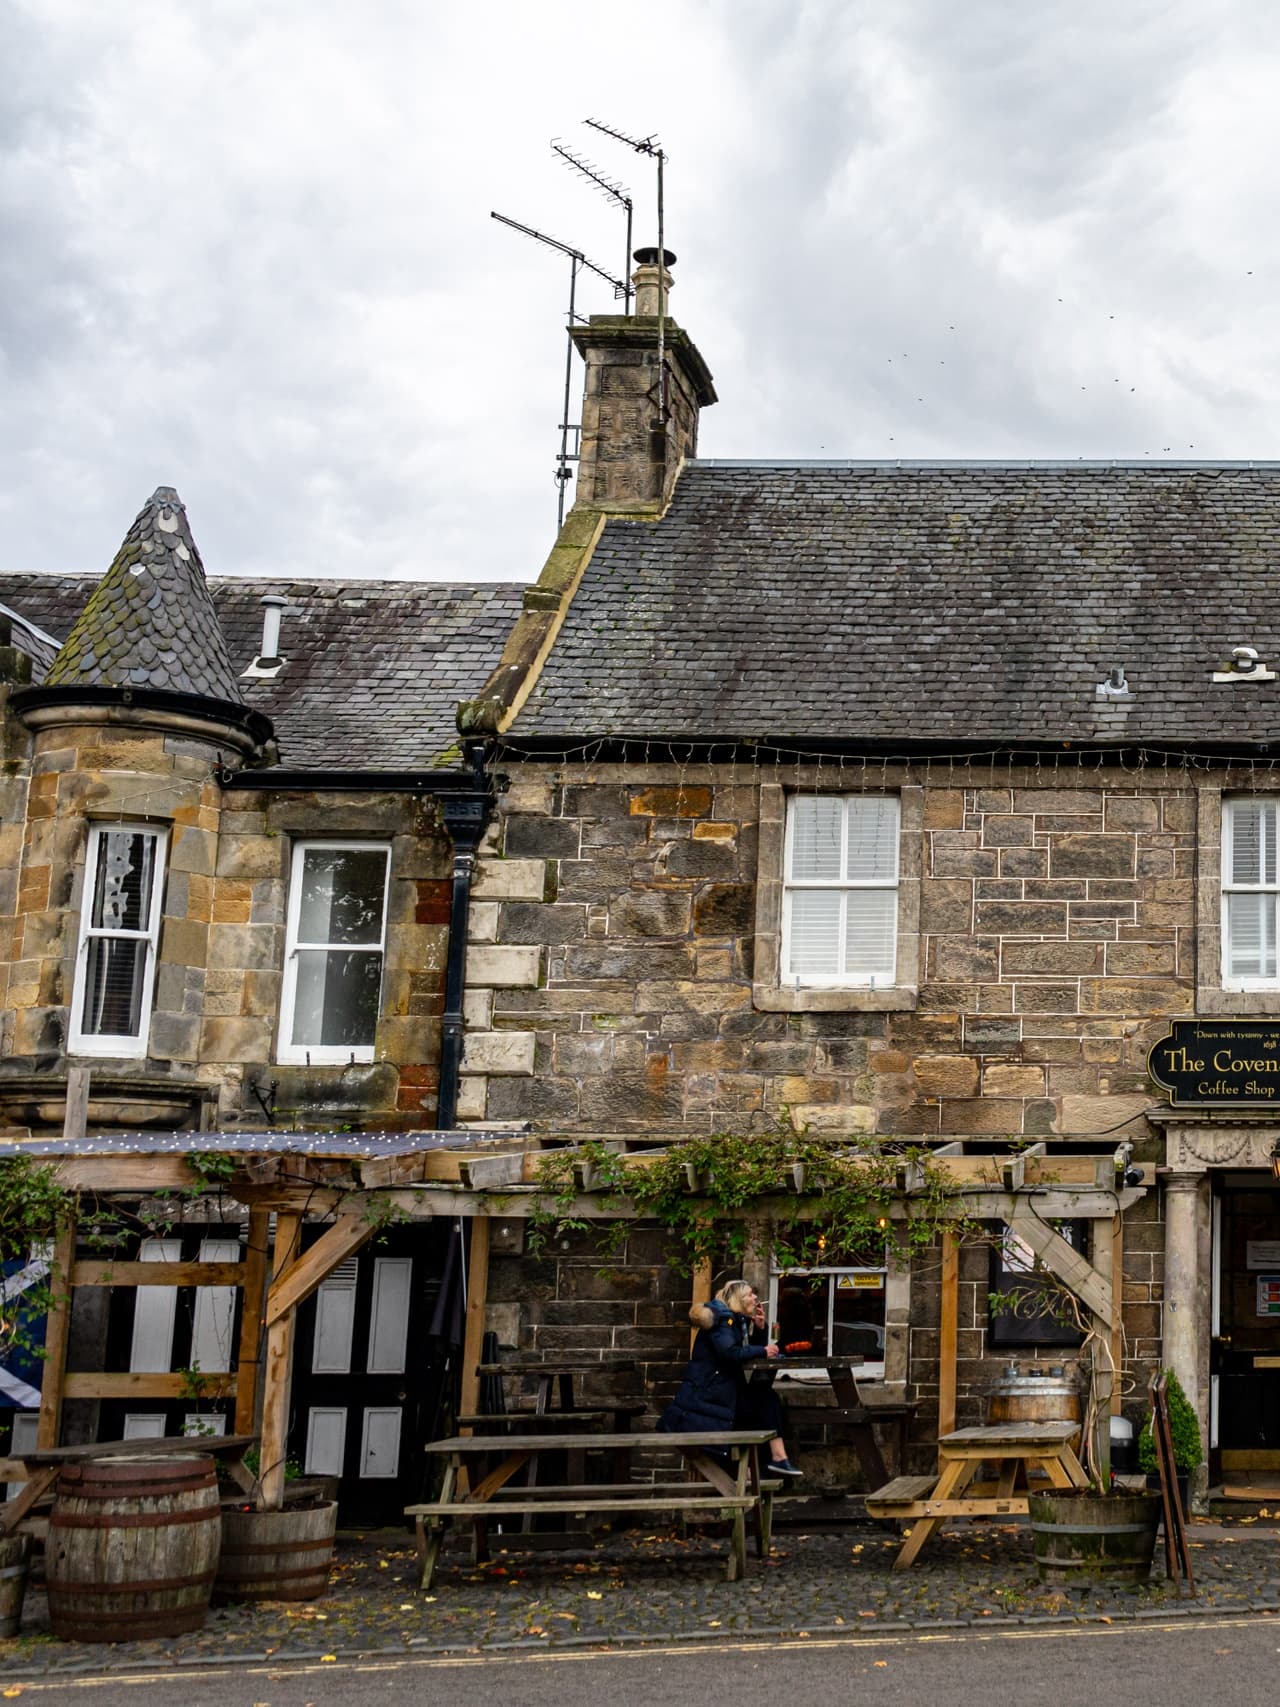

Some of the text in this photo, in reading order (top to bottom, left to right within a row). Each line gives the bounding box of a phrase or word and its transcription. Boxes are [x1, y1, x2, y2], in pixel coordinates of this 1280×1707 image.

[1220, 1030, 1236, 1039] with
[1163, 1046, 1205, 1072] The
[1198, 1080, 1240, 1095] Coffee
[1244, 1080, 1275, 1098] Shop
